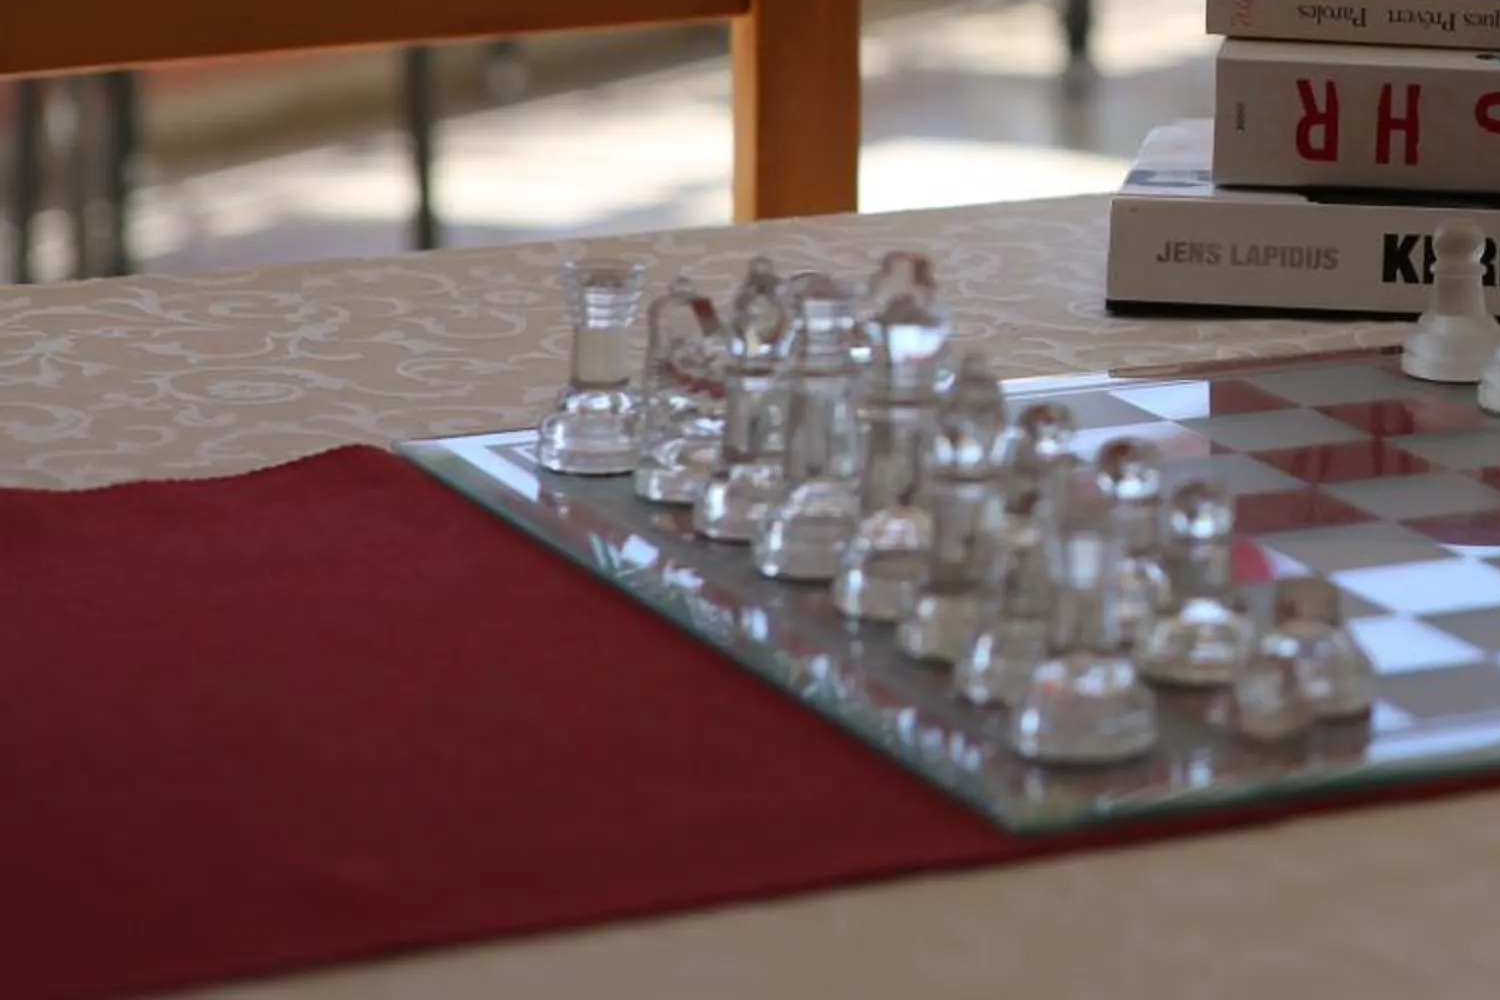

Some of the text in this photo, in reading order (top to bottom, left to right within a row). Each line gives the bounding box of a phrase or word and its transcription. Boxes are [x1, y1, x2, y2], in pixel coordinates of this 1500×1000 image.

[1296, 3, 1367, 29] Paroles
[1387, 8, 1456, 32] Prévert
[1155, 240, 1341, 271] JENS LAPIDUS
